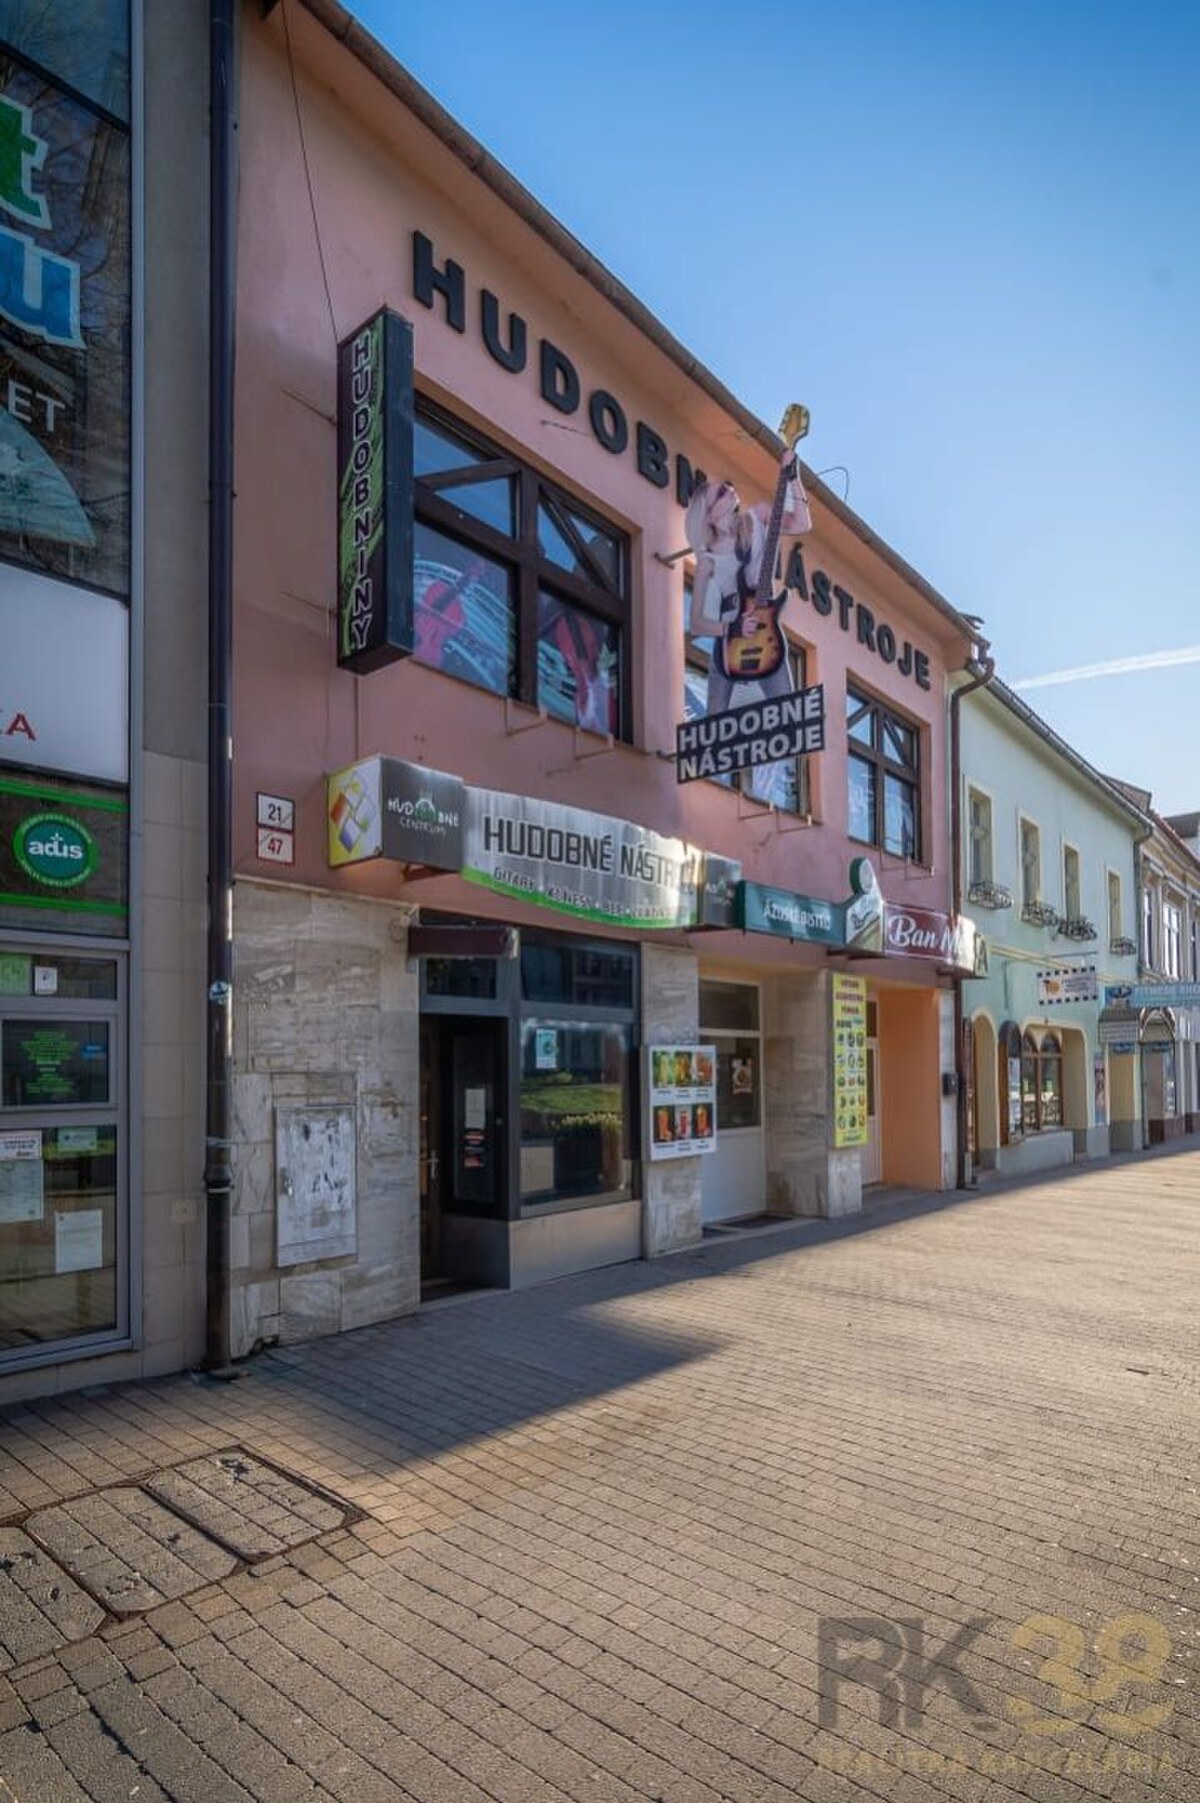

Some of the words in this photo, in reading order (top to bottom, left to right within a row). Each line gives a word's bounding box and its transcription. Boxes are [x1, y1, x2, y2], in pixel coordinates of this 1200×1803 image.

[412, 229, 707, 508] HUDOBN
[351, 329, 374, 651] HUDOBNINY
[775, 541, 931, 691] ÁSTROJE
[0, 709, 37, 742] A
[679, 690, 823, 753] HUDOBNÉ
[679, 726, 823, 782] NÁSTROJE
[267, 803, 282, 822] 21
[267, 838, 283, 856] 47
[484, 815, 613, 873] HUDOBNÉ
[888, 914, 936, 947] Ban
